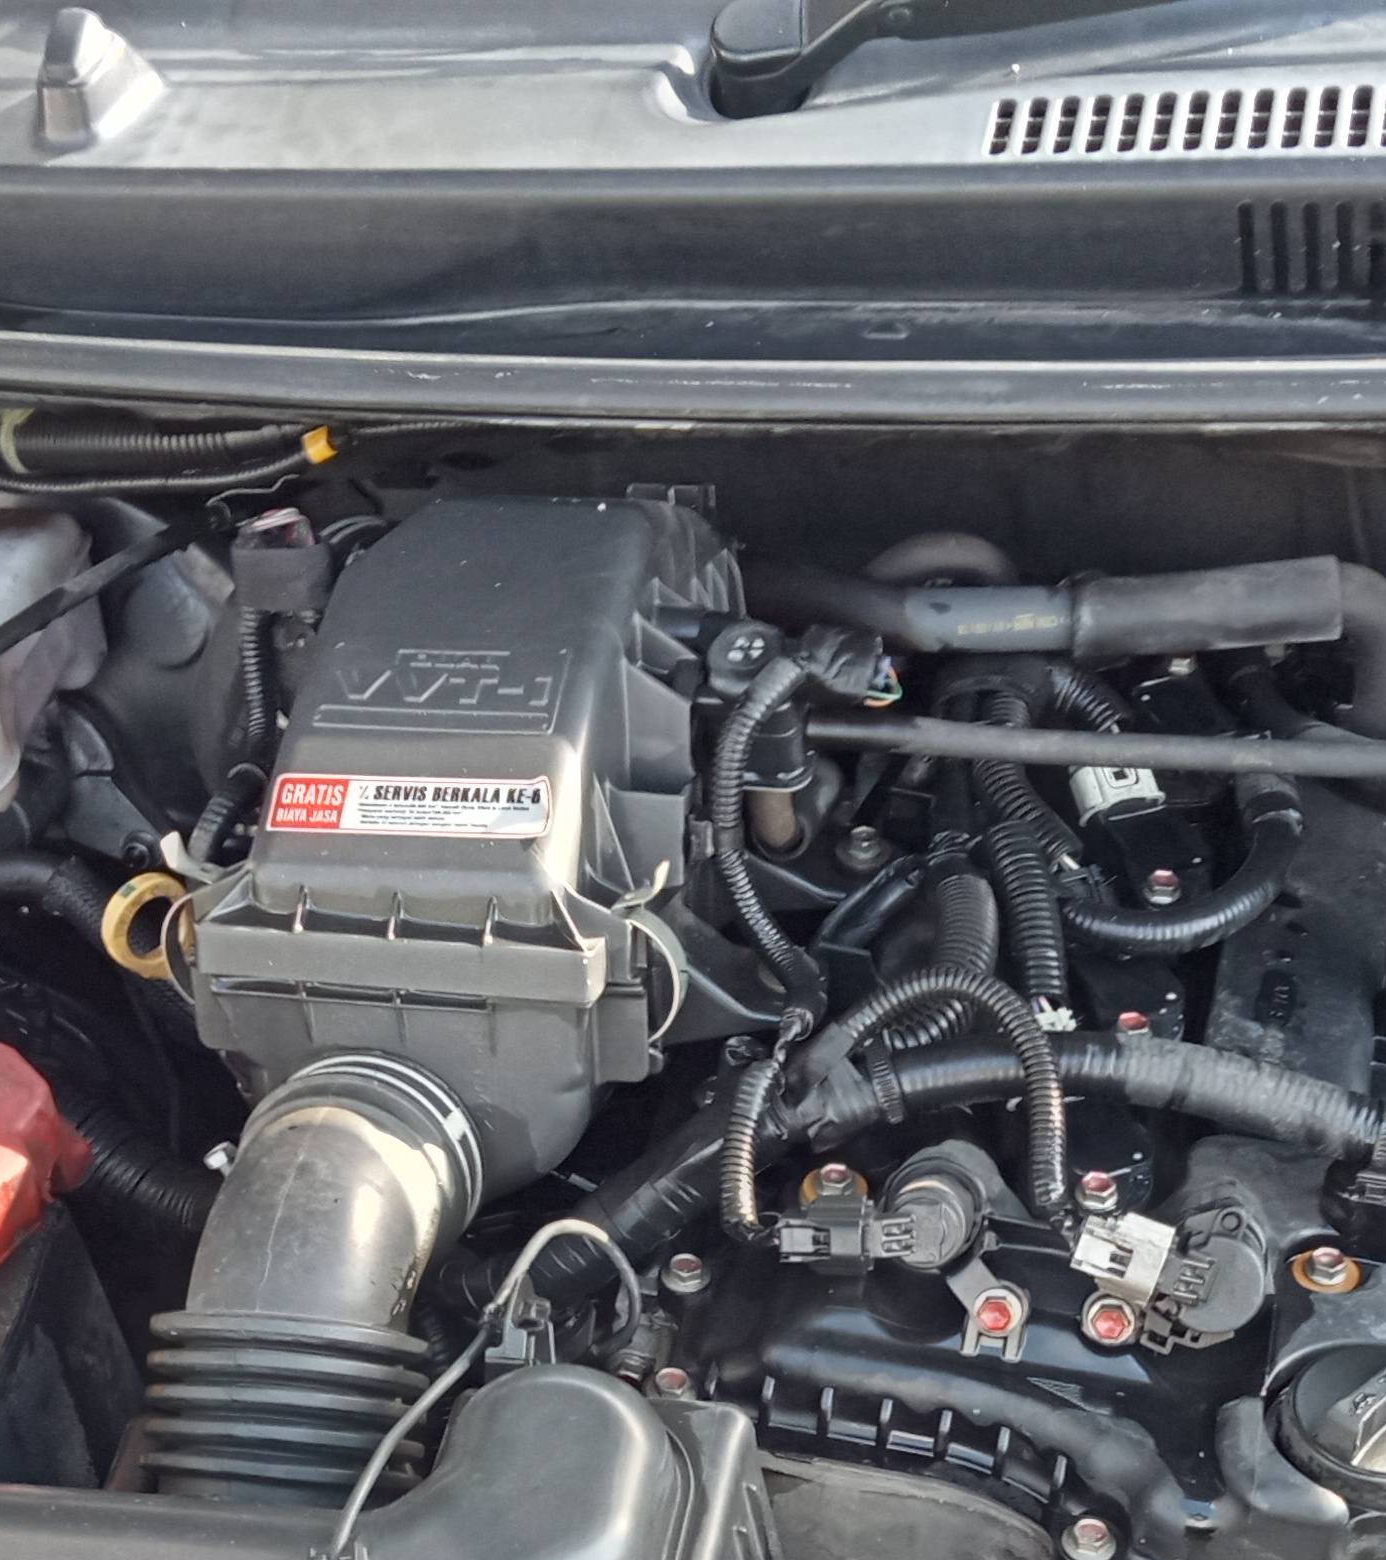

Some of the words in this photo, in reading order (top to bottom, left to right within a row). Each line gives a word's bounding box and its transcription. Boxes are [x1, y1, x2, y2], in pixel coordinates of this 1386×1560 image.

[281, 783, 344, 806] GRATIS
[373, 785, 428, 802] SERVIS
[431, 786, 501, 804] BERKALA
[275, 807, 306, 823] BIAYA
[309, 808, 338, 824] JASA
